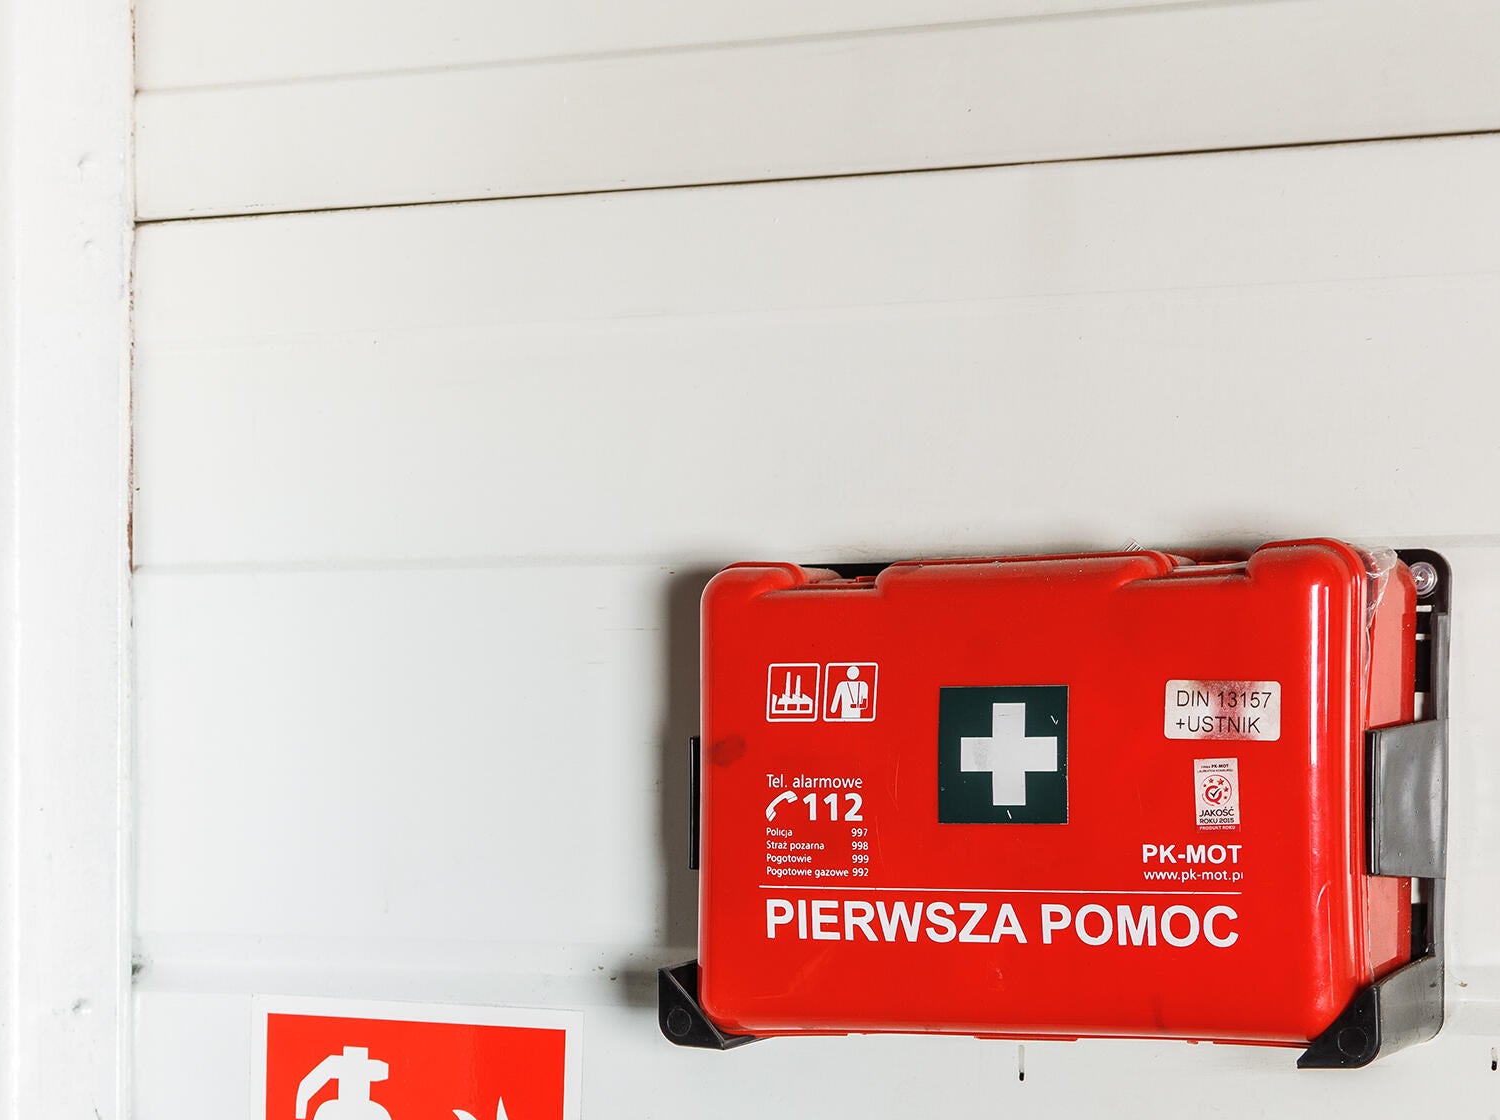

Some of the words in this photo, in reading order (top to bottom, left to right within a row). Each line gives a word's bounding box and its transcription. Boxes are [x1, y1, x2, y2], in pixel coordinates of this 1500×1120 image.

[1176, 690, 1209, 707] DIN
[1217, 692, 1272, 708] 13157
[1176, 716, 1260, 734] +USTNIK
[766, 774, 787, 788] Tel.
[793, 774, 862, 788] alarmowe
[802, 792, 863, 821] 112
[1199, 806, 1234, 817] JAKOŚĆ
[766, 827, 793, 838] Policja
[851, 828, 867, 837] 997
[766, 840, 787, 850] Straż
[852, 842, 868, 850] 998
[766, 854, 812, 864] Pogotowie
[852, 855, 869, 863] 999
[1142, 844, 1242, 864] PK-MOT
[766, 866, 812, 877] Pogotowie
[814, 869, 848, 878] gazowe
[852, 868, 868, 877] 992
[766, 899, 1028, 944] PIERWSZA
[1041, 904, 1239, 948] POMOC
